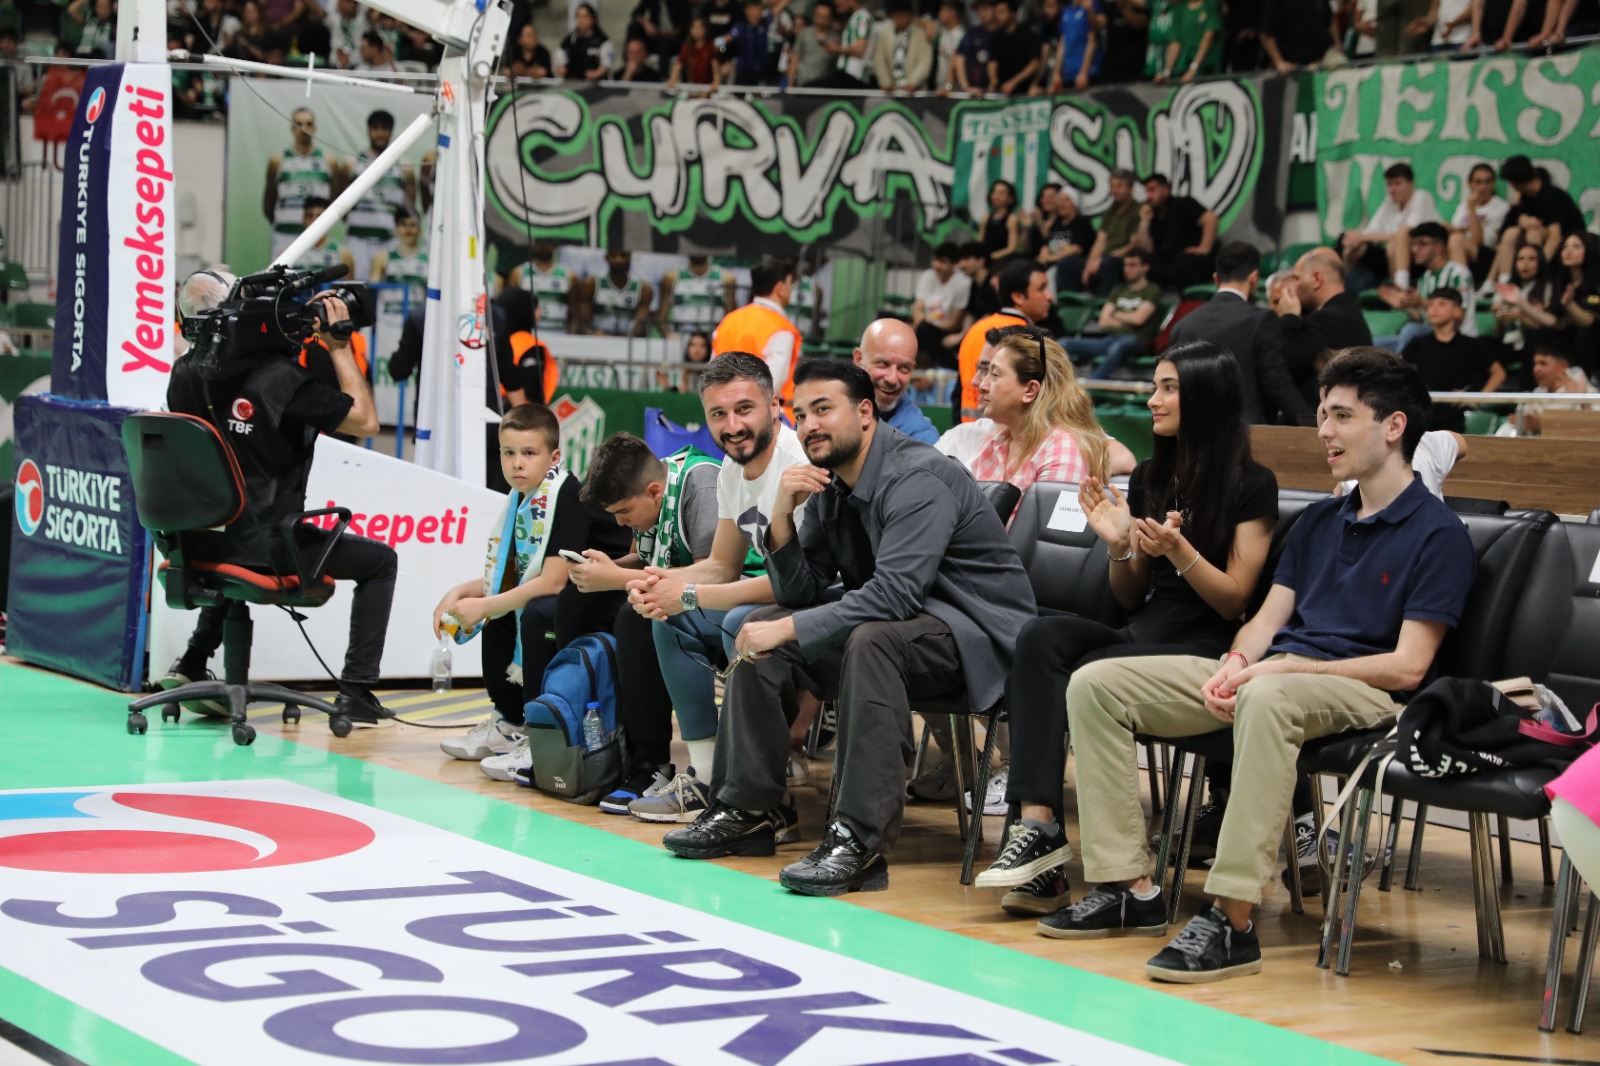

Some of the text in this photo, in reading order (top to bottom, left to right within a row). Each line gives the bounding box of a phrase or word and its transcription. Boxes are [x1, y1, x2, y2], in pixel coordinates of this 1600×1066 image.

[1324, 51, 1600, 148] TEKS
[121, 84, 174, 374] Yemeksepeti
[227, 419, 254, 435] TBF
[45, 464, 121, 512] TÜRKİYE
[44, 504, 122, 554] SİGORTA
[0, 890, 678, 1066] SİGO
